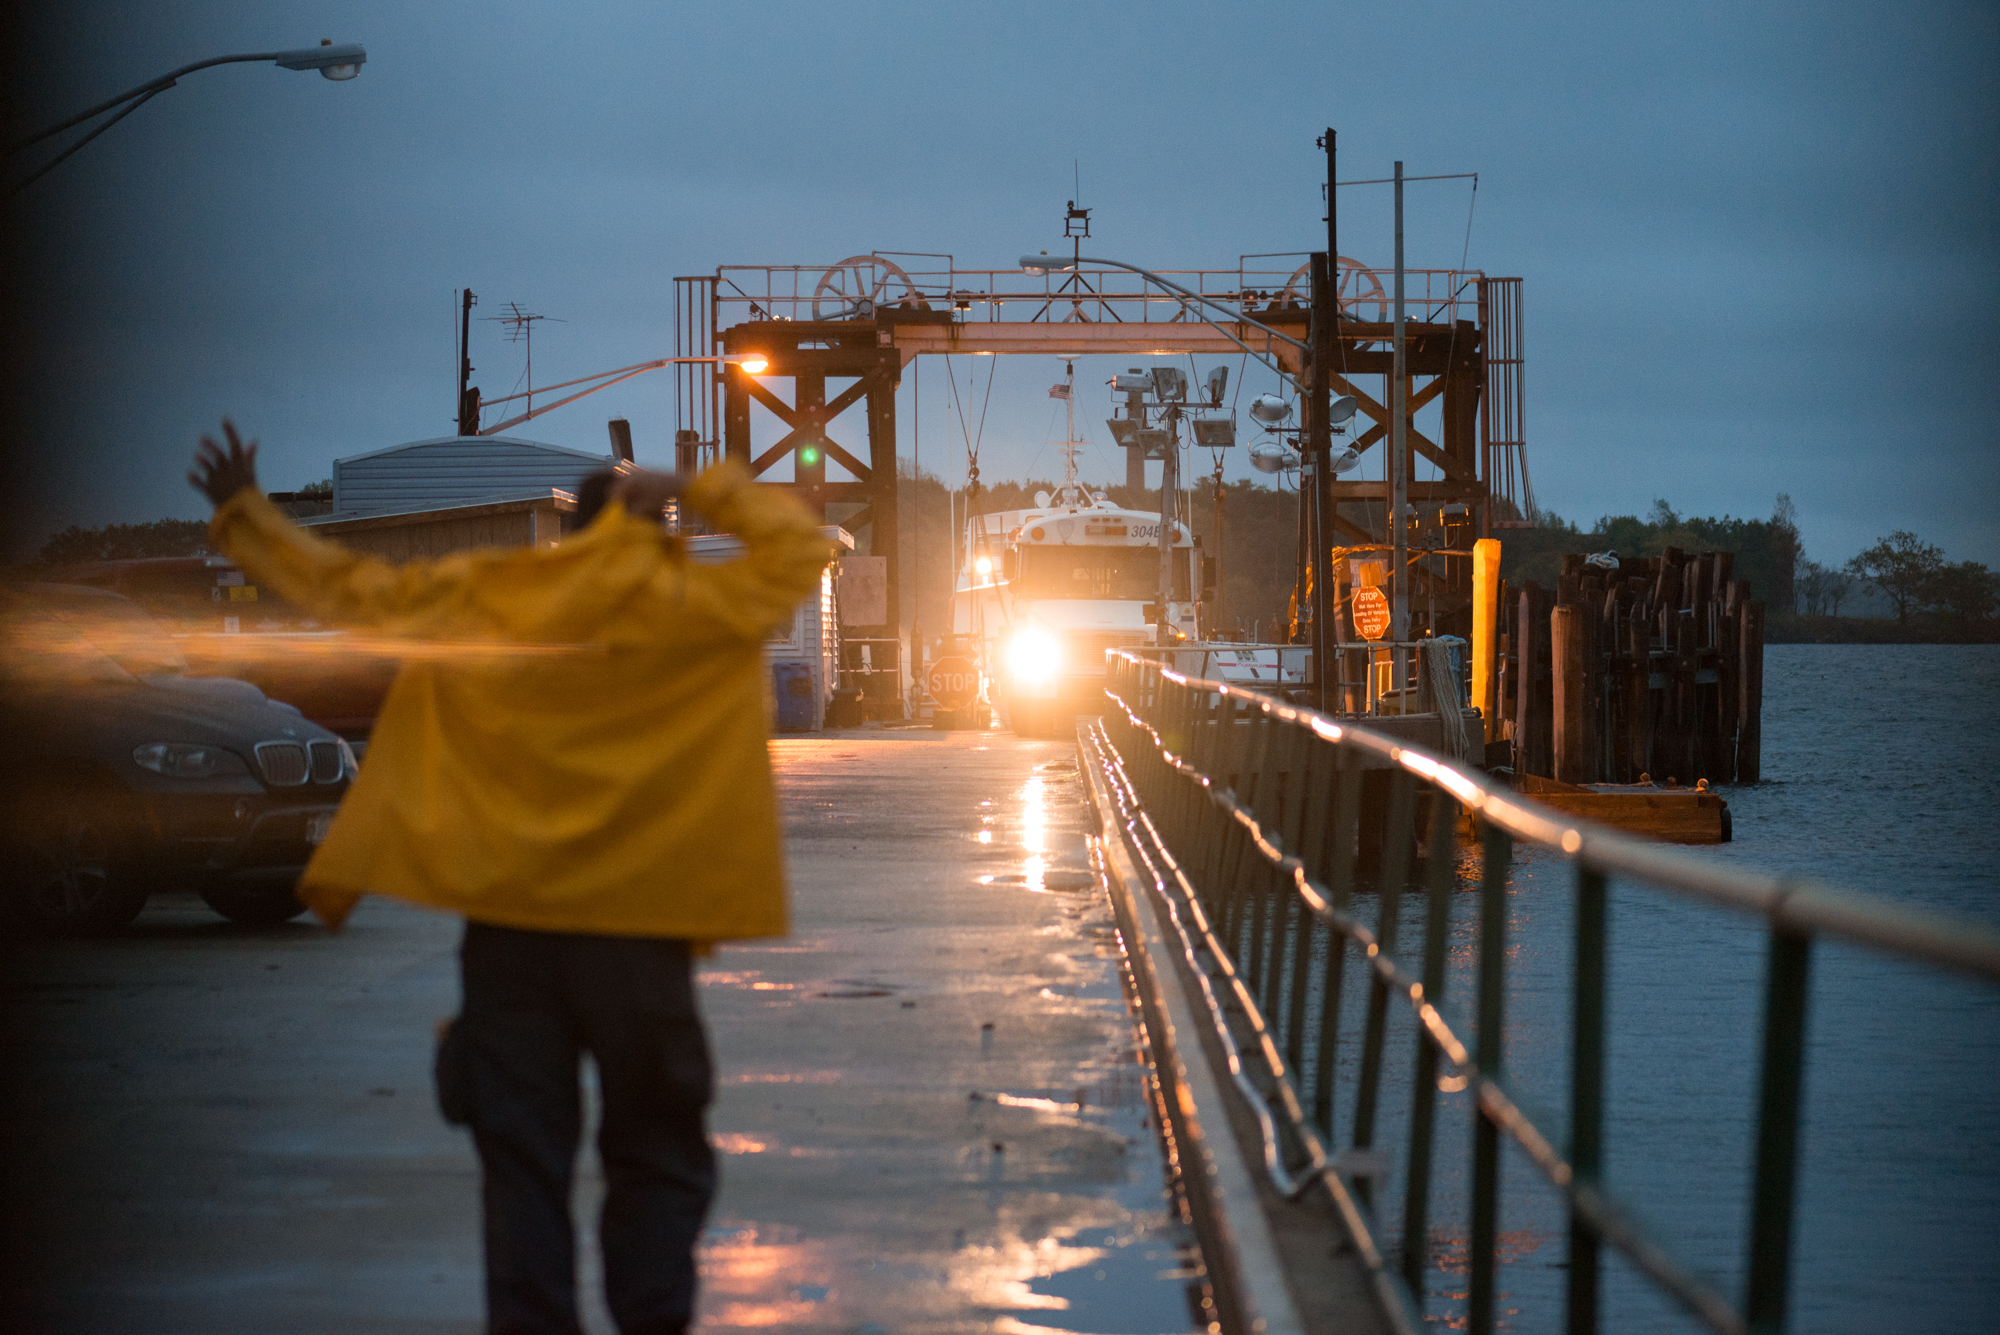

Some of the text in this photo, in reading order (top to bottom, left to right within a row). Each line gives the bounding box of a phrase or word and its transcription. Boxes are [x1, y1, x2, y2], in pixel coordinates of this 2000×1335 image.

[1360, 592, 1378, 601] STOP
[1364, 624, 1381, 634] STOP
[932, 673, 975, 692] STOP
